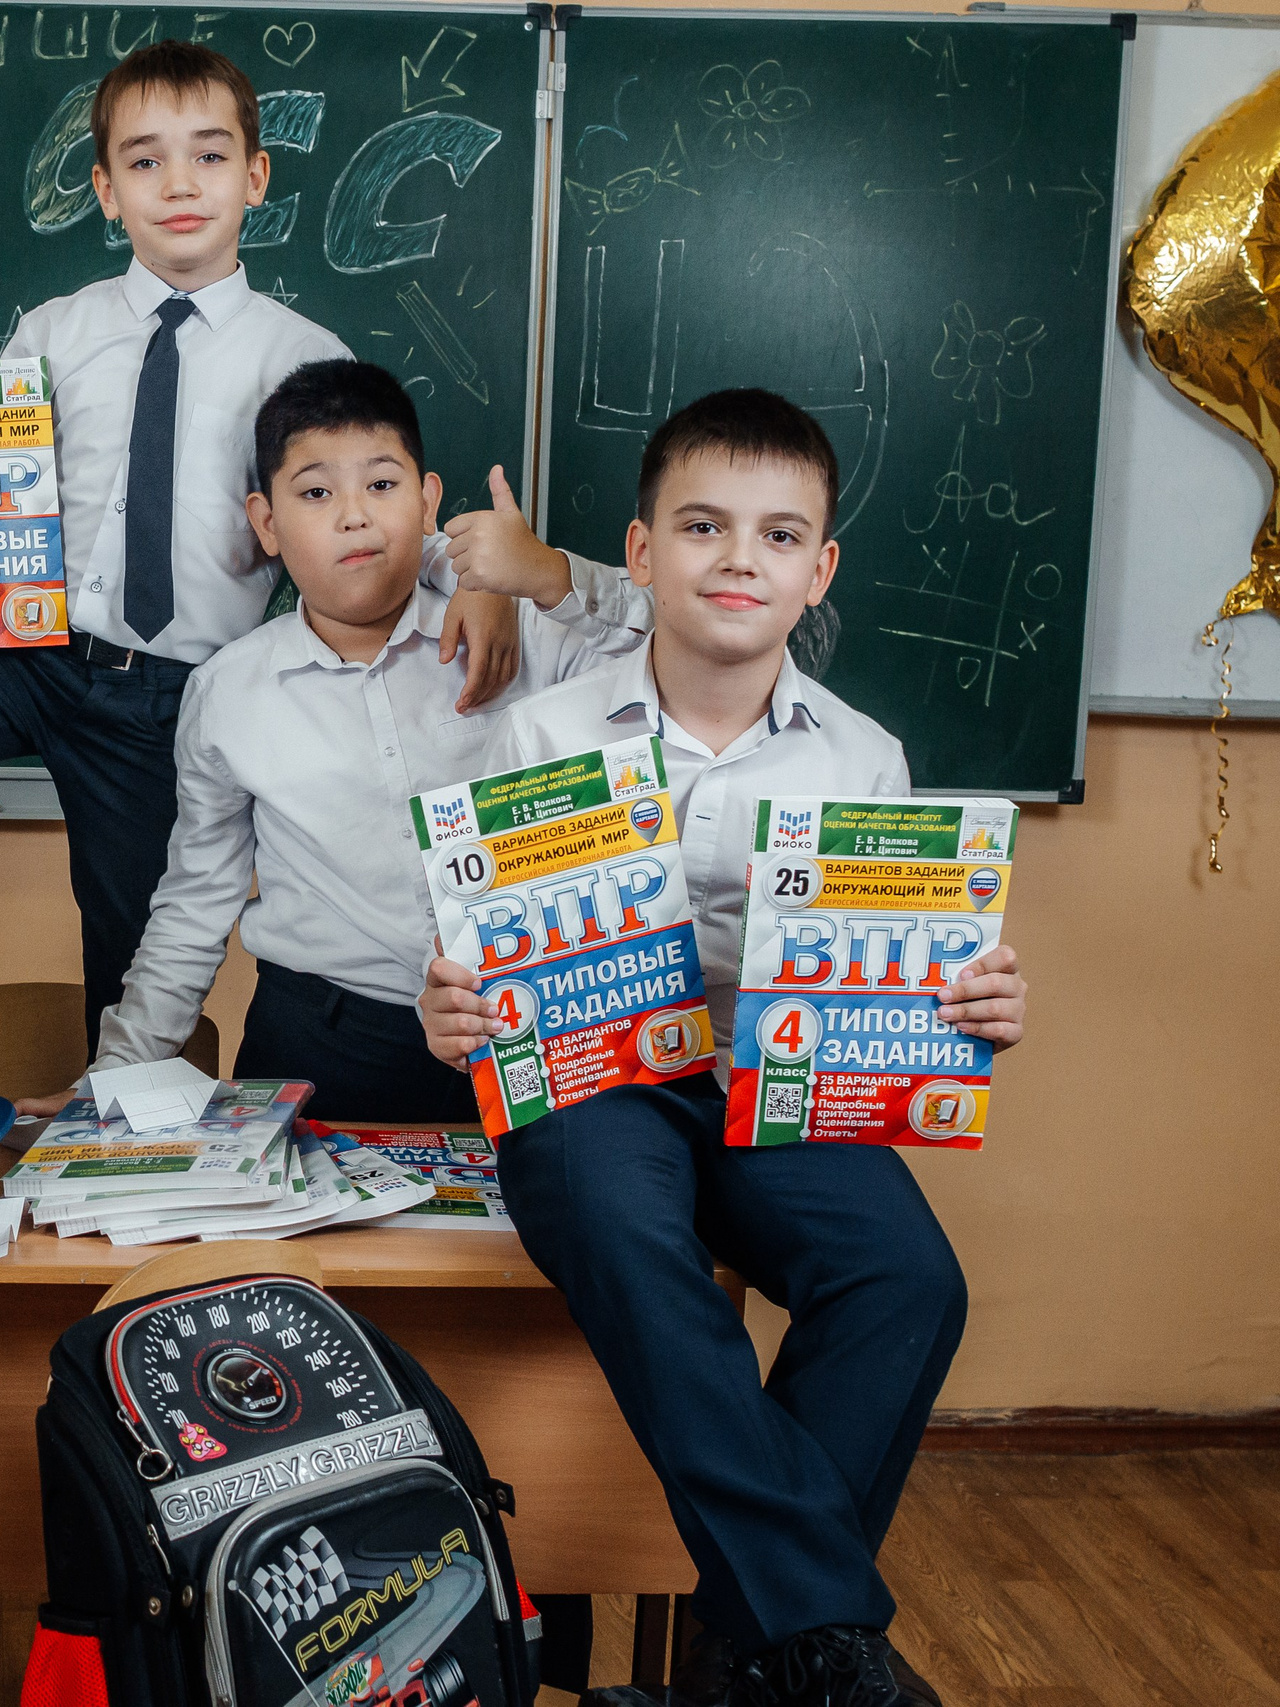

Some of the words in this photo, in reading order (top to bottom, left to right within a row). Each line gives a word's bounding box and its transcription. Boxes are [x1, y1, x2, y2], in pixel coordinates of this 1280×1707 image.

[14, 367, 36, 375] Денис
[9, 424, 40, 437] МИР
[13, 438, 41, 446] РАБОТА
[476, 795, 509, 809] ОЦЕНКИ
[509, 784, 547, 801] КАЧЕСТВА
[546, 770, 602, 793] ОБРАЗОВАНИЯ
[490, 772, 548, 795] ФЕДЕРАЛЬНЫЙ
[549, 764, 586, 781] ИНСТИТУТ
[614, 782, 656, 798] СтатГрад
[512, 805, 521, 815] Е.
[522, 803, 532, 813] В.
[533, 793, 572, 810] Волкова
[534, 802, 574, 820] Цитович
[823, 820, 856, 830] ОЦЕНКИ
[857, 821, 897, 832] КАЧЕСТВА
[898, 823, 957, 832] ОБРАЗОВАНИЯ
[840, 811, 902, 821] ФЕДЕРАЛЬНЫЙ
[903, 813, 942, 822] ИНСТИТУТ
[435, 826, 473, 842] ФИОКО
[492, 824, 566, 853] ВАРИАНТОВ
[569, 807, 626, 834] ЗАДАНИЙ
[856, 835, 865, 845] Е.
[867, 836, 877, 845] В.
[879, 836, 919, 846] Волкова
[498, 833, 596, 873] ОКРУЖАЮЩИЙ
[601, 828, 630, 847] МИР
[773, 840, 812, 849] ФИОКО
[878, 846, 918, 856] Цитович
[961, 849, 1004, 859] СтатГрад
[446, 852, 485, 886] 10
[499, 864, 556, 886] ВСЕРОССИЙСКАЯ
[556, 851, 607, 872] ПРОВЕРОЧНАЯ
[606, 844, 633, 859] РАБОТА
[825, 864, 902, 876] ВАРИАНТОВ
[905, 865, 965, 878] ЗАДАНИЙ
[774, 867, 809, 897] 25
[823, 883, 925, 898] ОКРУЖАЮЩИЙ
[932, 886, 962, 897] МИР
[819, 898, 879, 907] ВСЕРОССИЙСКАЯ
[880, 899, 933, 908] ПРОВЕРОЧНАЯ
[934, 900, 962, 908] РАБОТА
[462, 855, 666, 975] ВПР
[770, 913, 982, 989] ВПР
[537, 940, 685, 1000] ТИПОВЫЕ
[497, 989, 522, 1030] 4
[545, 970, 686, 1028] ЗАДАНИЯ
[548, 1039, 560, 1050] 10
[562, 1019, 632, 1046] ВАРИАНТОВ
[772, 1010, 803, 1053] 4
[498, 1041, 535, 1060] класс
[549, 1036, 603, 1060] ЗАДАНИЙ
[822, 1039, 974, 1069] ЗАДАНИЯ
[552, 1049, 615, 1074] Подробные
[554, 1061, 604, 1083] критерии
[766, 1067, 807, 1077] класс
[556, 1067, 620, 1092] оценивания
[820, 1075, 835, 1086] 25
[836, 1076, 911, 1087] ВАРИАНТОВ
[558, 1086, 599, 1104] Ответы
[819, 1085, 877, 1097] ЗАДАНИЙ
[817, 1110, 870, 1119] критерии
[818, 1100, 886, 1111] Подробные
[814, 1128, 857, 1139] Ответы
[815, 1118, 885, 1128] оценивания
[462, 1153, 490, 1164] 4
[174, 1313, 198, 1337] 160
[206, 1303, 231, 1329] 180
[246, 1310, 271, 1335] 200
[160, 1338, 181, 1360] 140
[276, 1326, 302, 1350] 220
[305, 1348, 331, 1372] 240
[158, 1372, 180, 1394] 120
[325, 1376, 352, 1398] 260
[248, 1395, 278, 1410] SPEED
[168, 1409, 191, 1430] 100
[336, 1408, 362, 1429] 280
[160, 1456, 302, 1526] GRIZZLY
[311, 1418, 439, 1477] GRIZZLY
[294, 1527, 471, 1672] FORMULA
